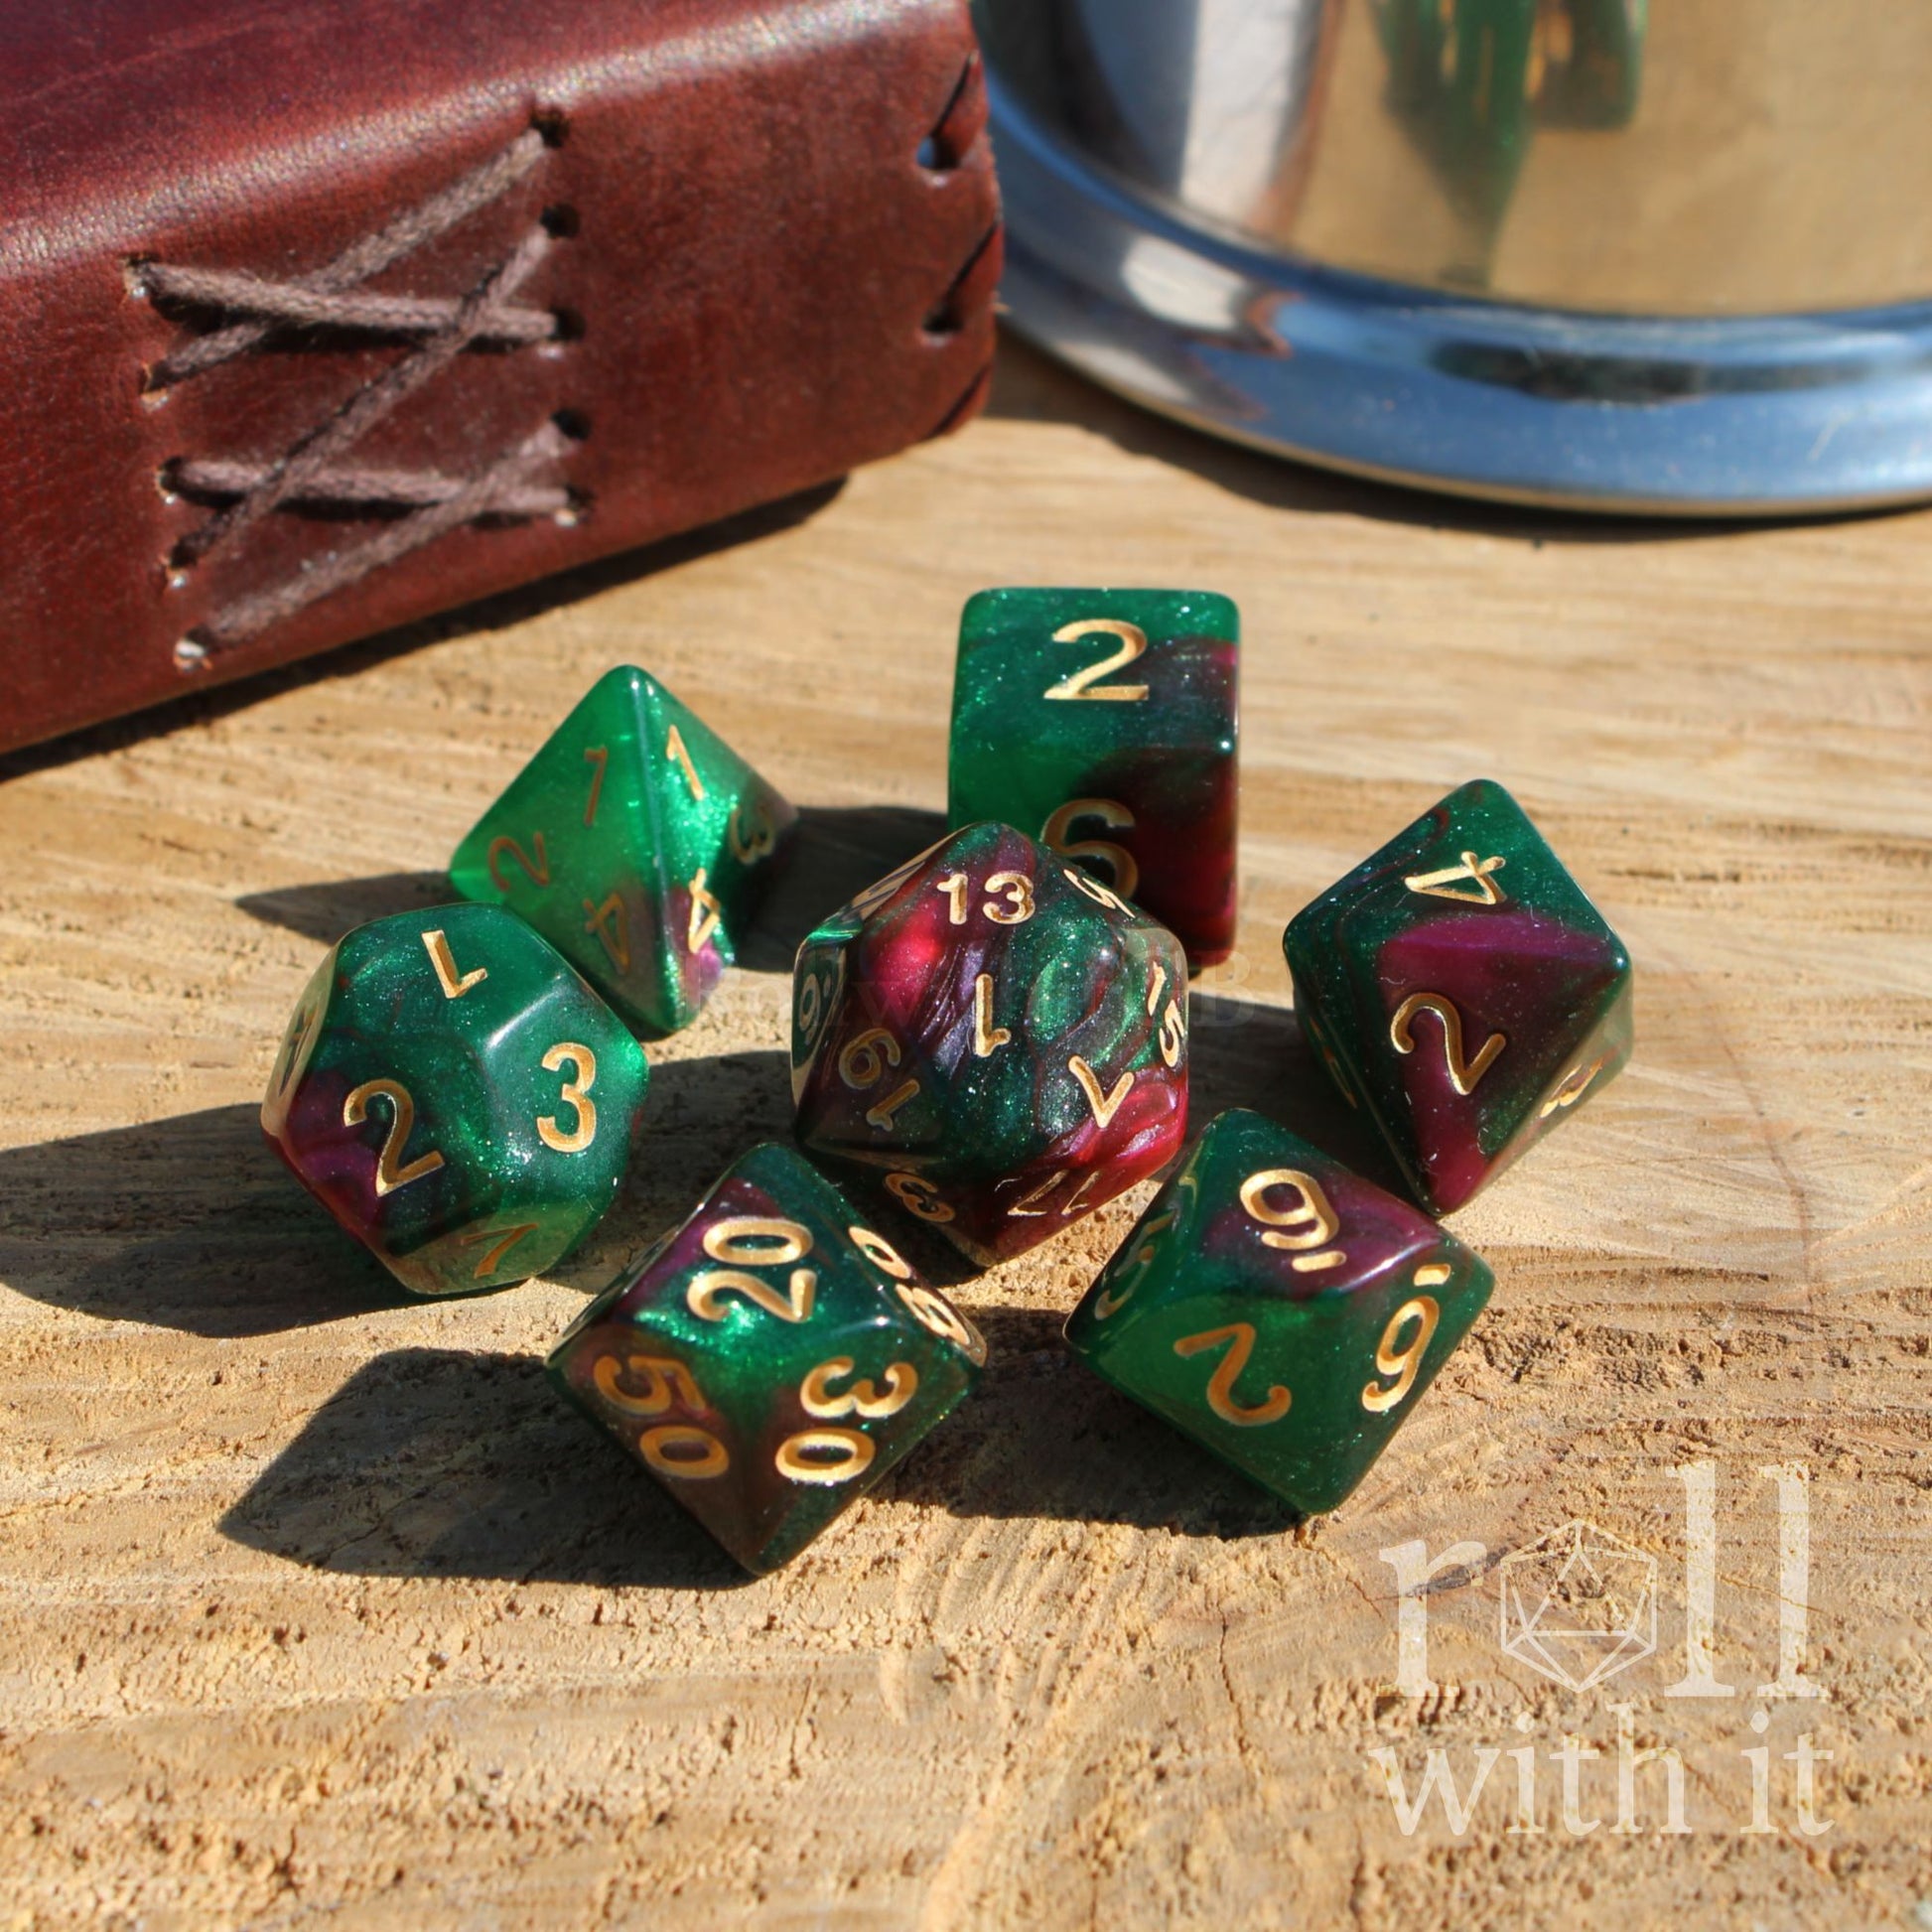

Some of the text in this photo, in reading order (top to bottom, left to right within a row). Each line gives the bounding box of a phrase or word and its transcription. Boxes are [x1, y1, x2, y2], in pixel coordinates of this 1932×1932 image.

[1043, 619, 1149, 701] 2
[666, 725, 705, 801] 1
[487, 831, 549, 892] 2
[1040, 798, 1139, 898] 6
[1404, 851, 1507, 904] 4
[583, 890, 630, 976] 4
[687, 868, 722, 953] 4
[937, 872, 1035, 925] 13
[973, 974, 1012, 1057] 1
[1391, 992, 1507, 1096] 2
[344, 1078, 446, 1197] 2
[537, 1042, 596, 1154] 3
[775, 1356, 918, 1486] 30
